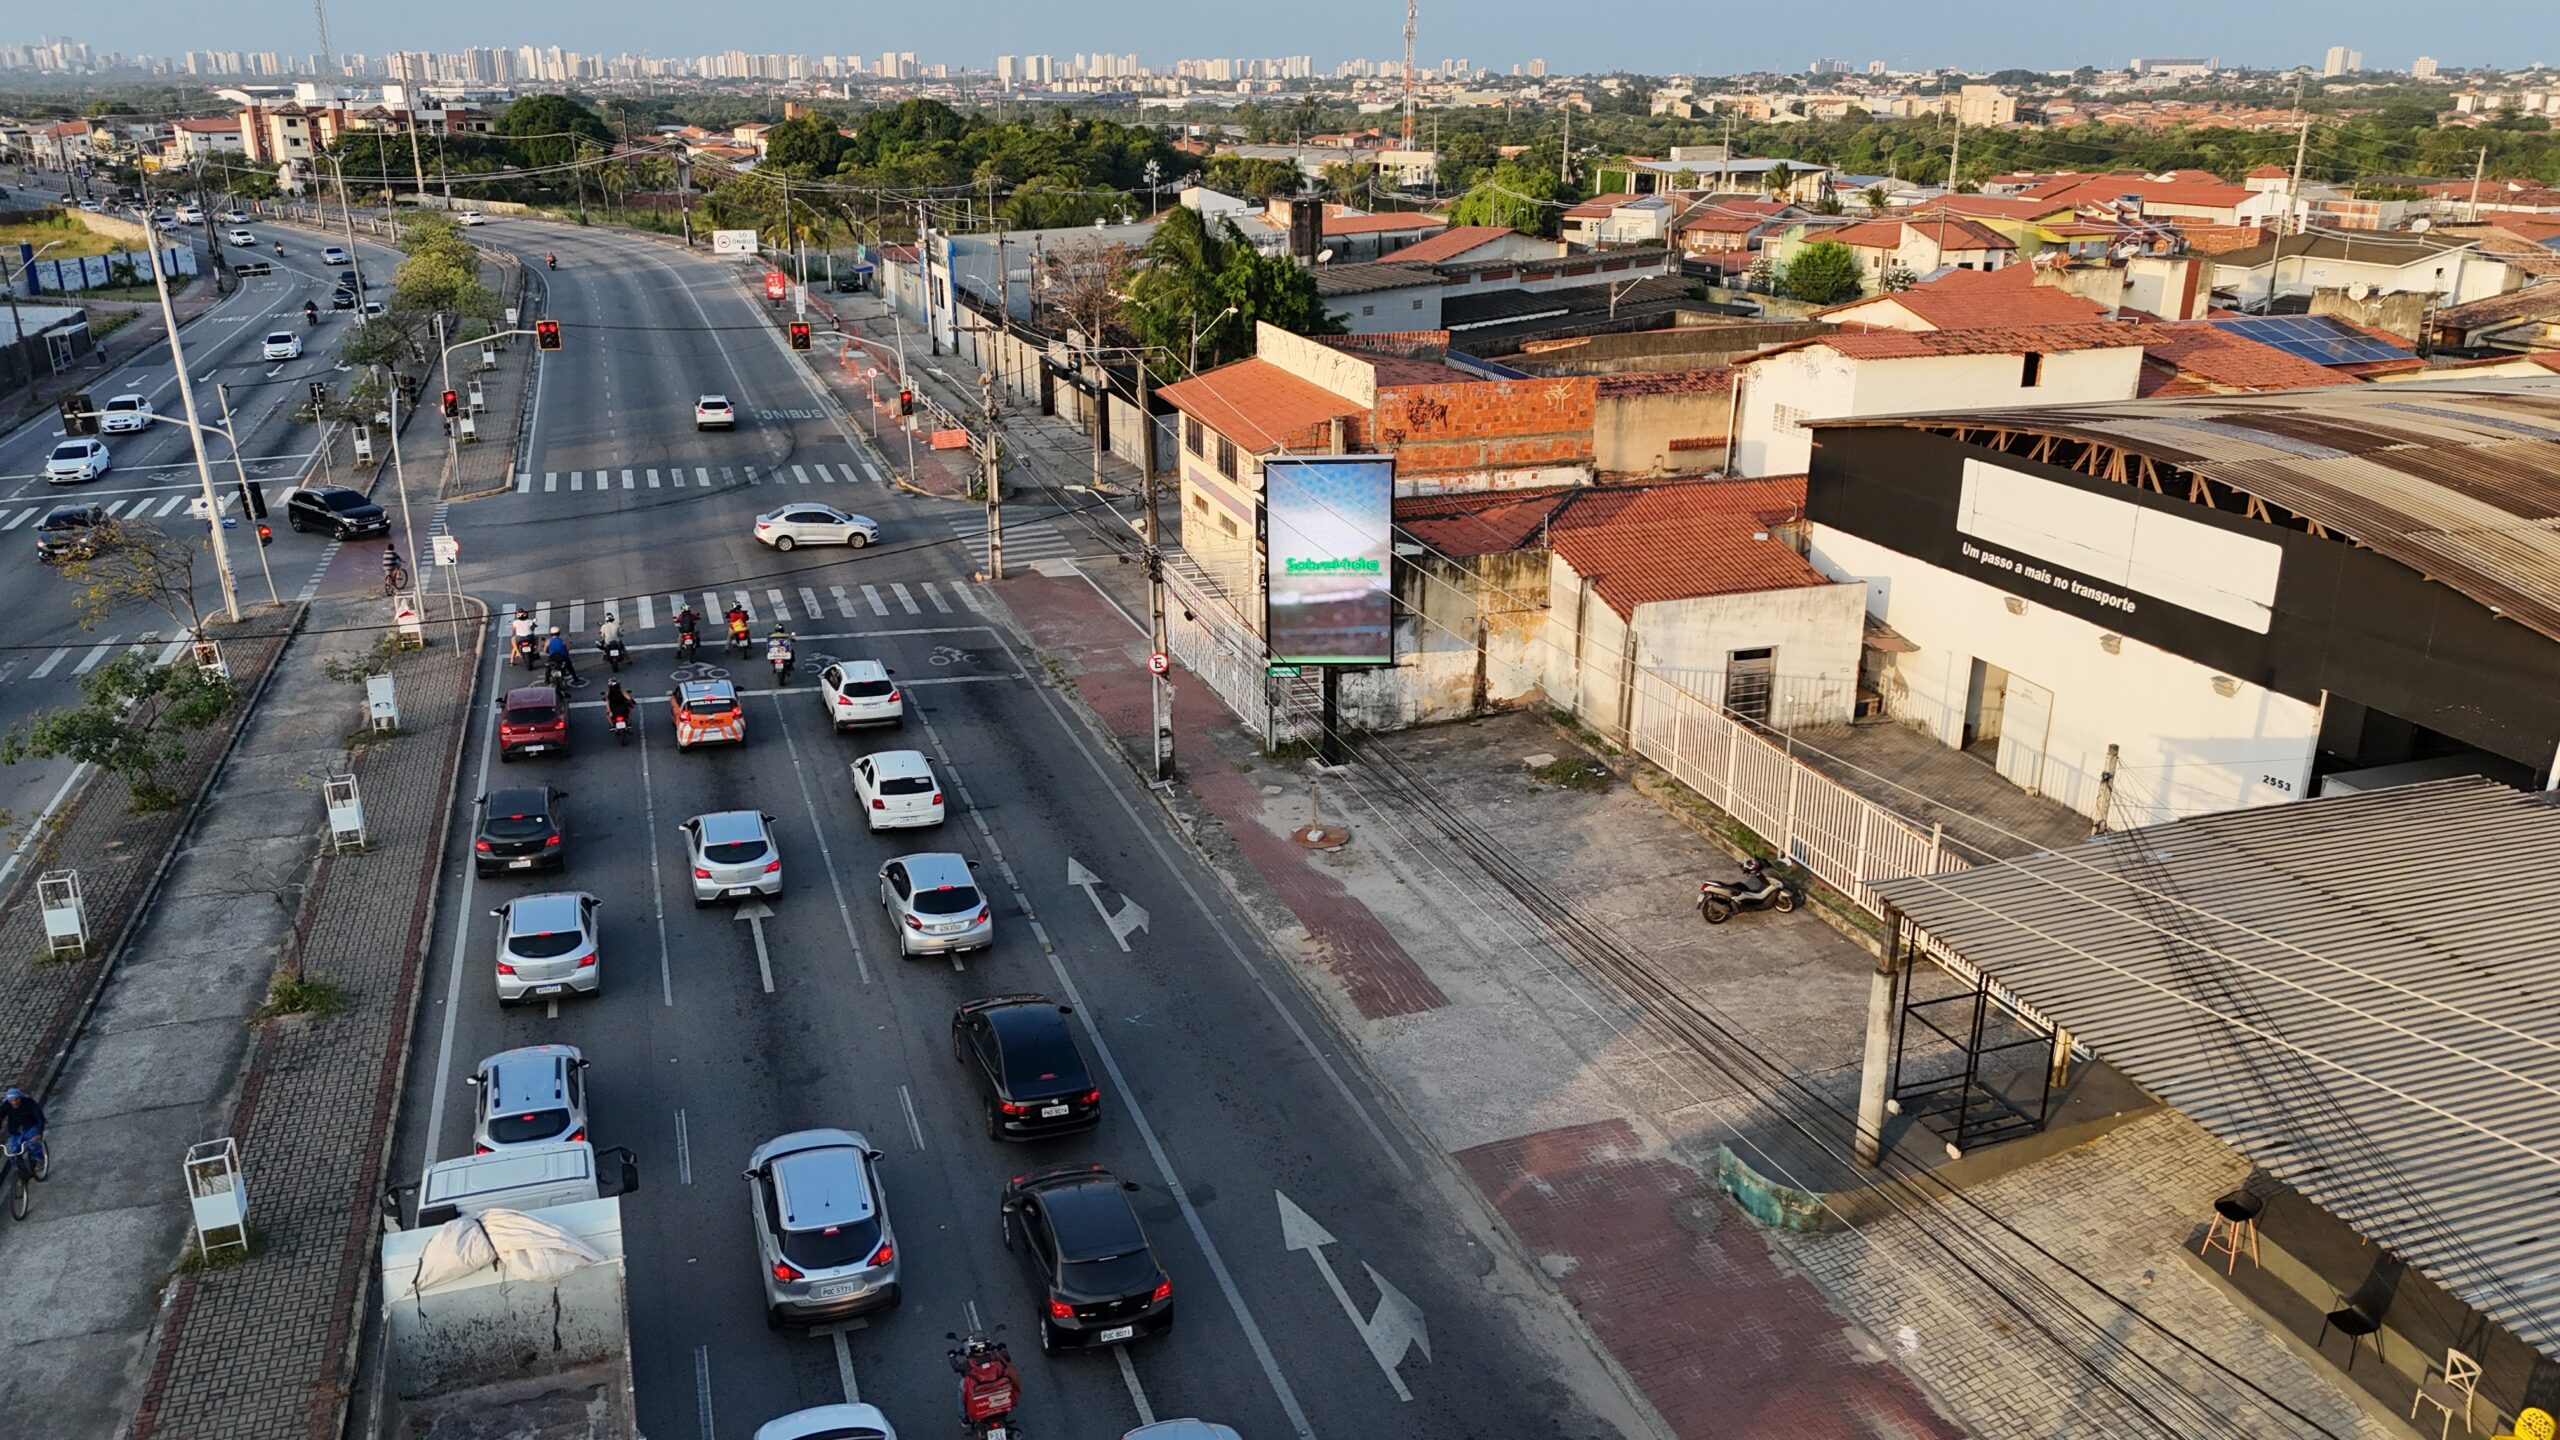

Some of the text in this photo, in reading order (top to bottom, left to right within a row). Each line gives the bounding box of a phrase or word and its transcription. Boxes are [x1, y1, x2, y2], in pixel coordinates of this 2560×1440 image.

[1962, 541, 2136, 613] Um passo a mais no transporte
[2262, 774, 2291, 791] 2553
